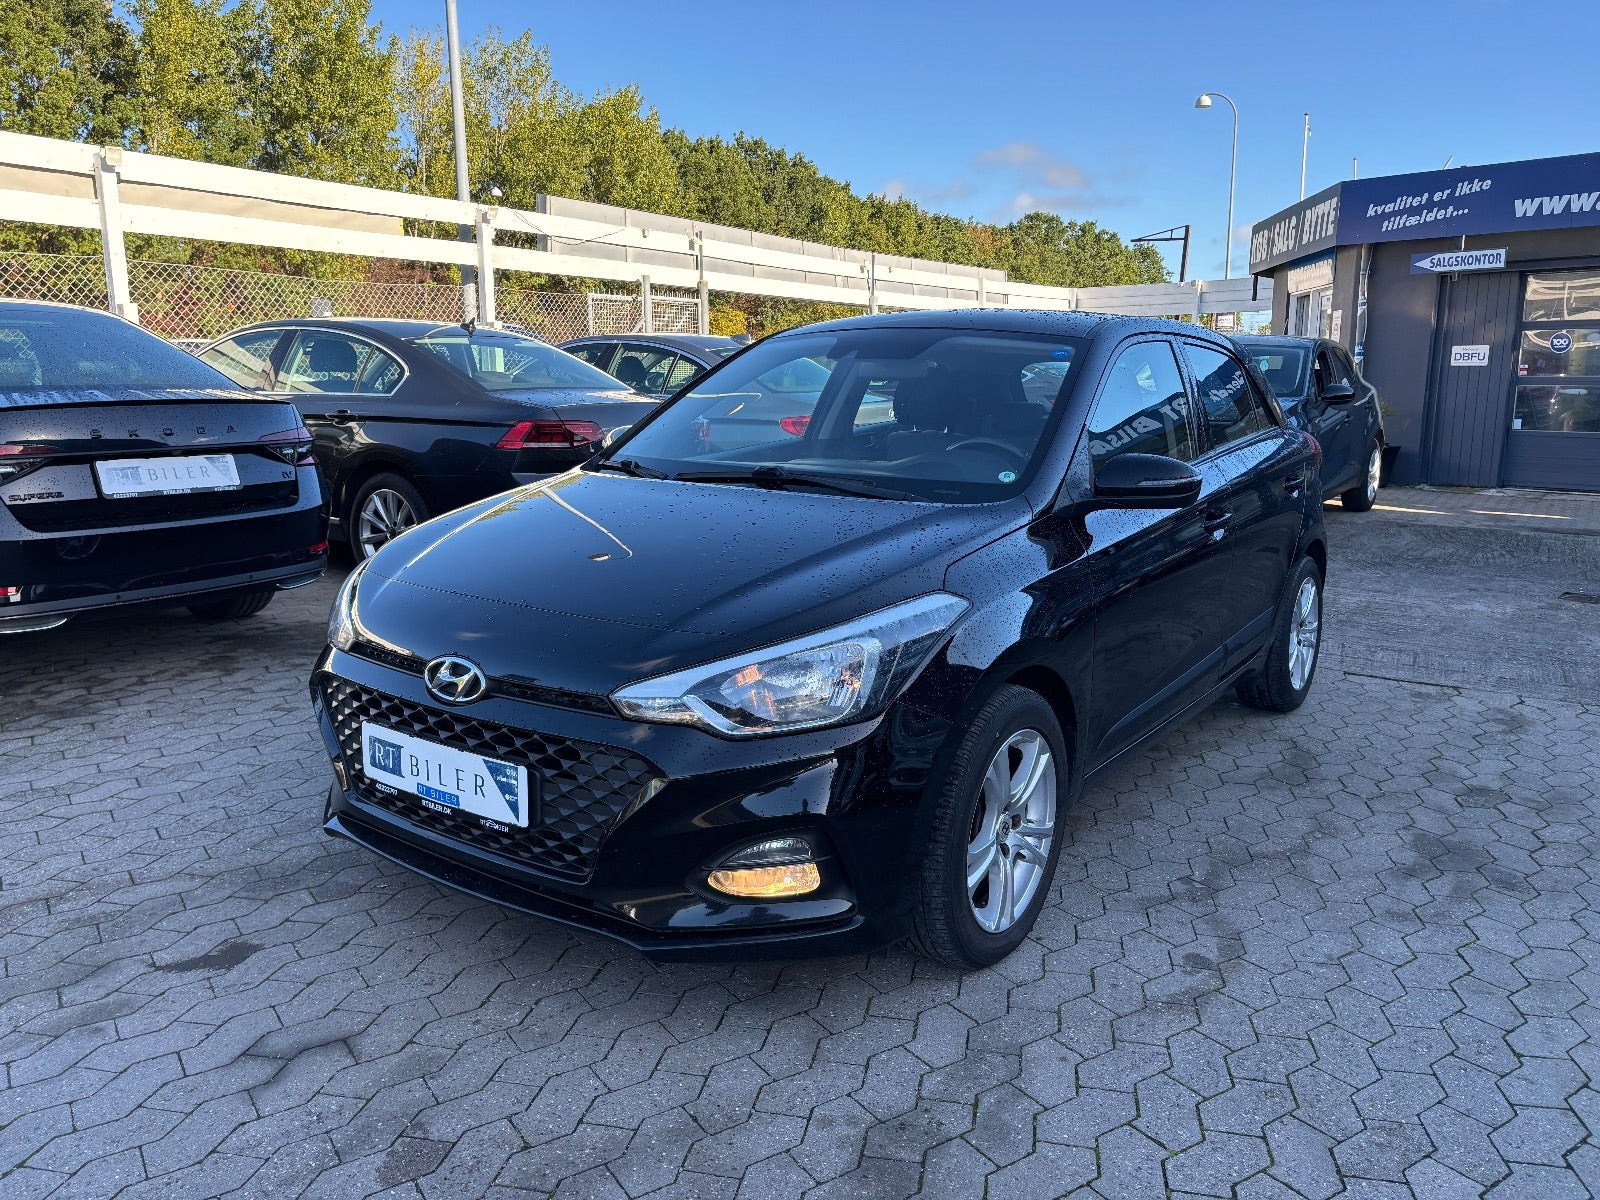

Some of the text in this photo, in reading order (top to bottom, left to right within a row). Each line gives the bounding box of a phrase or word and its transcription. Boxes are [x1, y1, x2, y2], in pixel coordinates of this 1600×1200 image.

[1366, 178, 1492, 217] kvalitet er ikke
[1251, 229, 1269, 264] KØB
[1273, 215, 1297, 256] SALG
[1302, 196, 1338, 245] BYTTE
[1429, 252, 1502, 269] SALGSKONTOR
[1454, 352, 1486, 361] DBFU
[147, 465, 211, 482] BILER
[374, 742, 396, 769] RT
[409, 754, 486, 799] BILER
